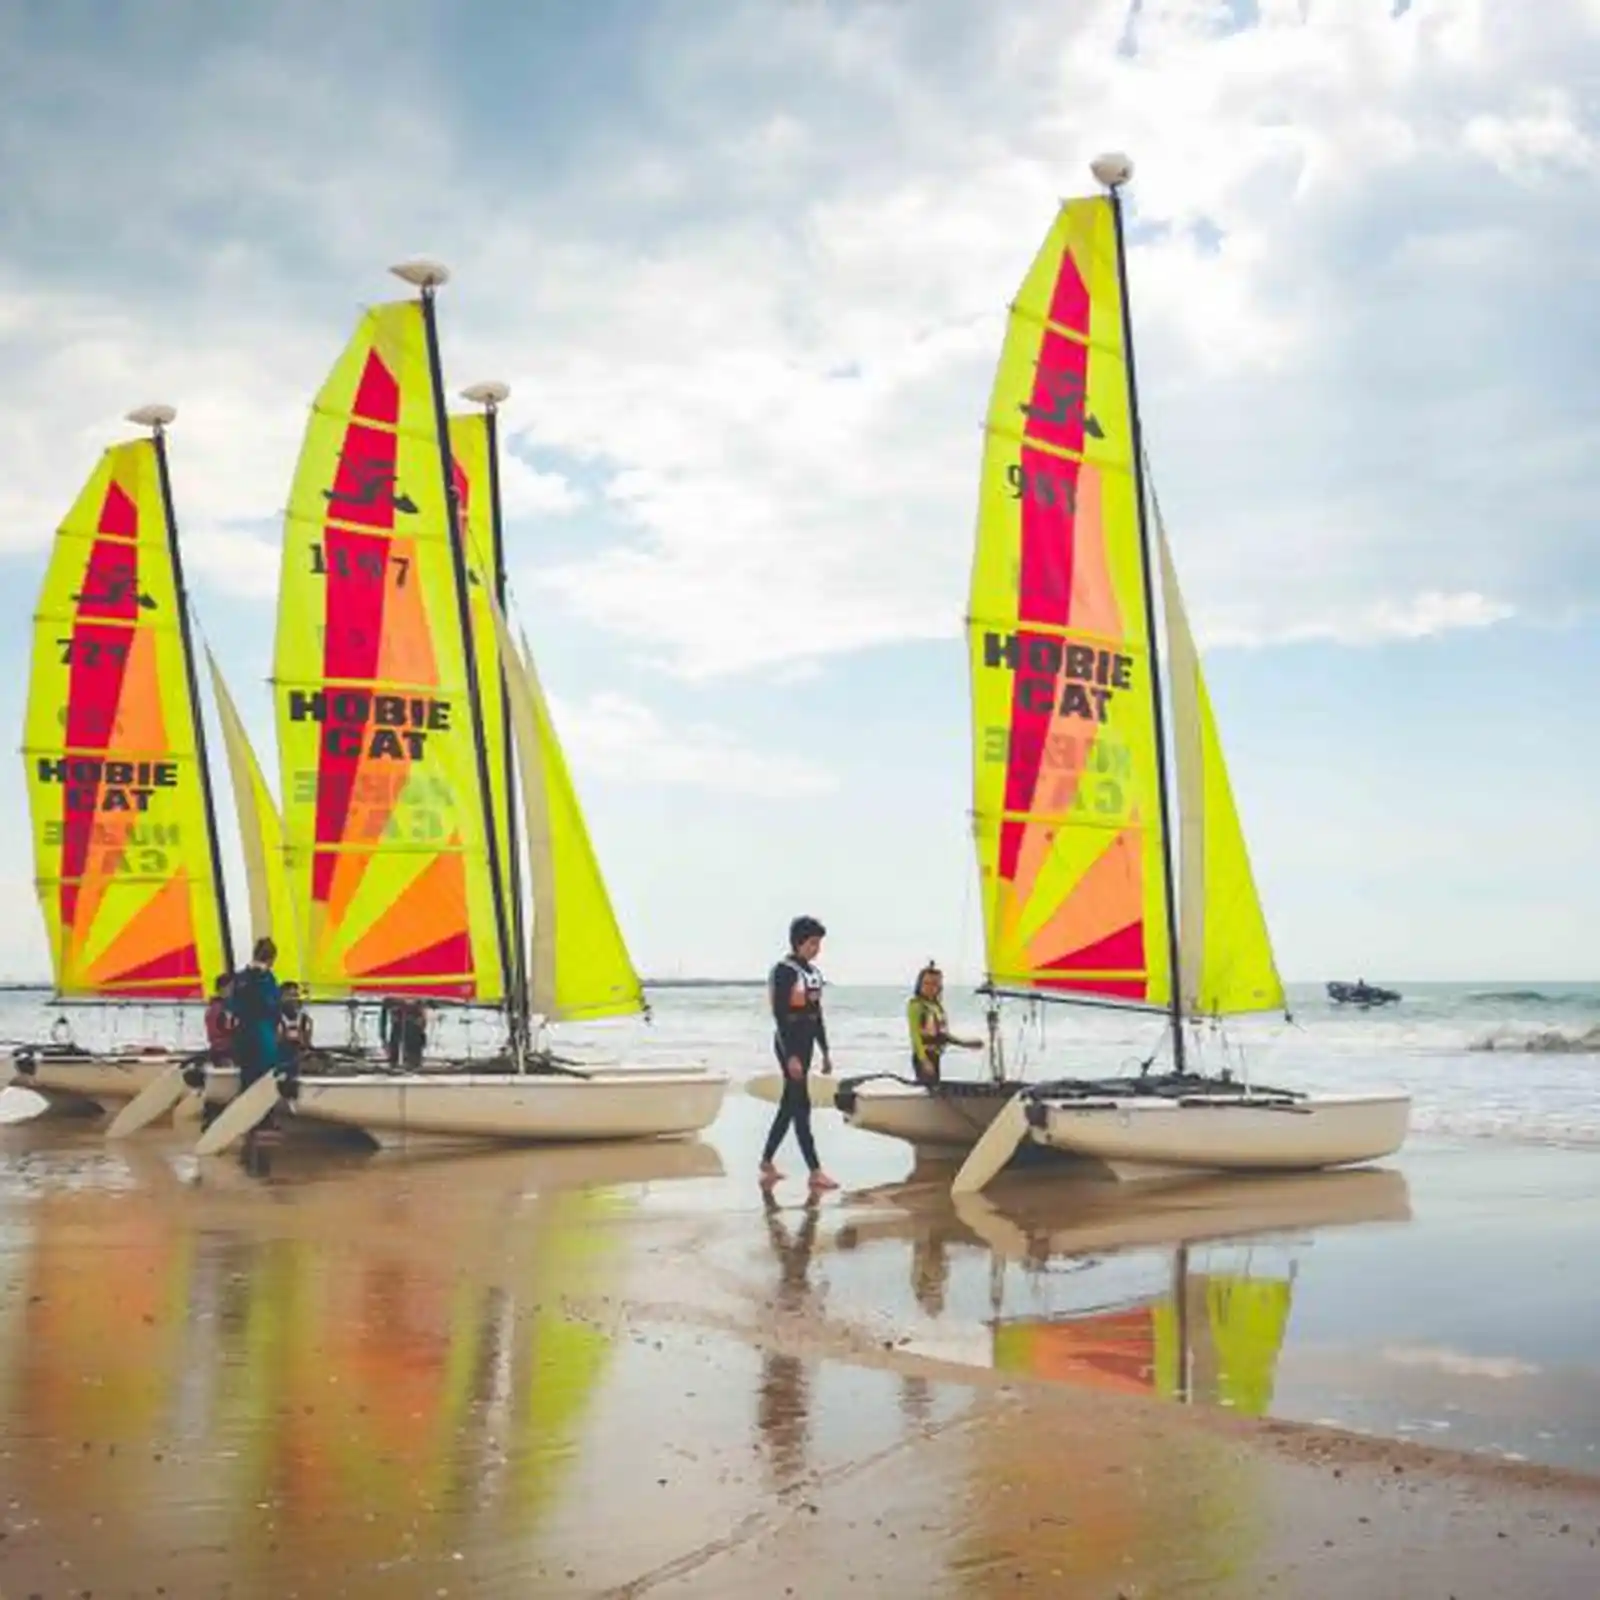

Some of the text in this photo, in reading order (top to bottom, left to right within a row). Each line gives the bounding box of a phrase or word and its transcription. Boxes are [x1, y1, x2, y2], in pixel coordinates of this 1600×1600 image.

[983, 633, 1134, 689] HOBIE
[289, 691, 451, 731] HOBIE
[1018, 678, 1114, 724] CAT
[326, 727, 427, 761] CAT
[37, 758, 178, 787] HOBIE
[68, 789, 154, 812] CAT
